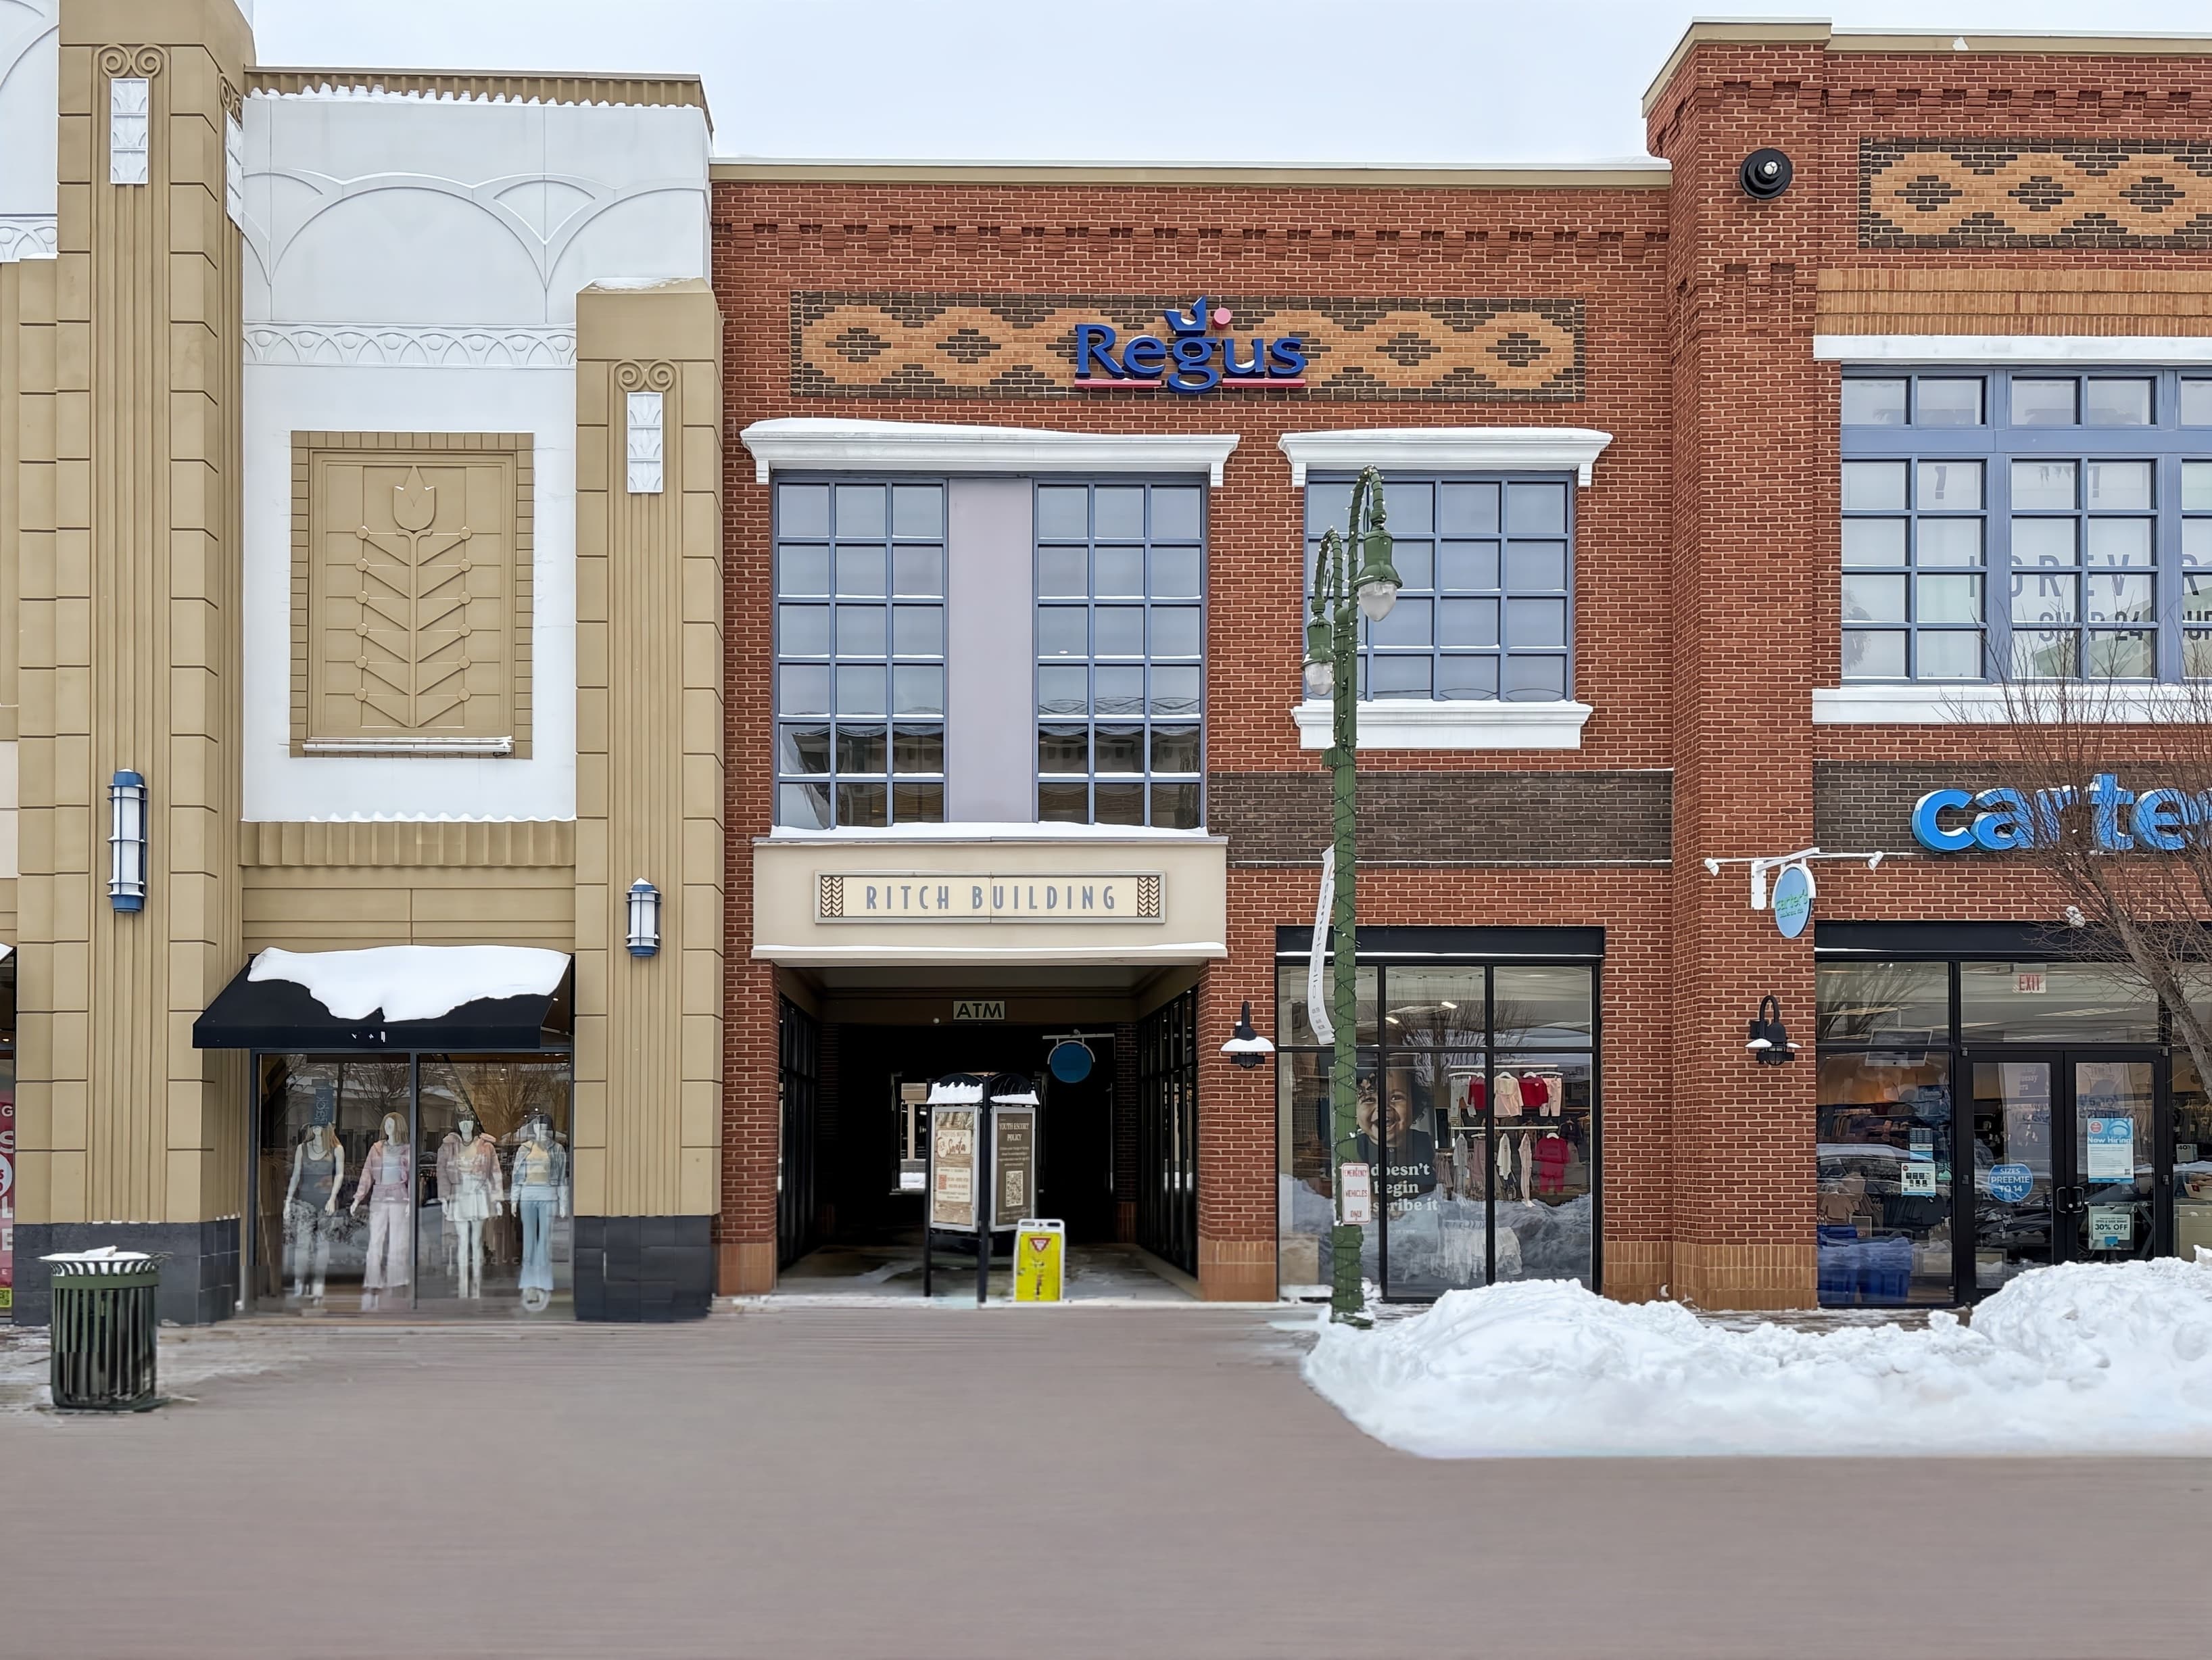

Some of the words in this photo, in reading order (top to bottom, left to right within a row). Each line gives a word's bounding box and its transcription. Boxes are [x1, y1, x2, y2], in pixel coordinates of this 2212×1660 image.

[1074, 323, 1307, 394] Regus
[2038, 611, 2105, 642] SHP
[1911, 773, 2212, 853] carte
[866, 885, 950, 909] RITCH
[972, 885, 1115, 910] BUILDING
[2019, 974, 2042, 991] EXIT
[956, 1002, 1003, 1019] ATM
[1344, 1169, 1368, 1177] EMERGENCY
[1345, 1189, 1368, 1197] VEHICLES
[1998, 1185, 2012, 1193] TO
[2013, 1185, 2023, 1193] 14
[1427, 1197, 1438, 1212] it
[1350, 1210, 1363, 1218] ONLY
